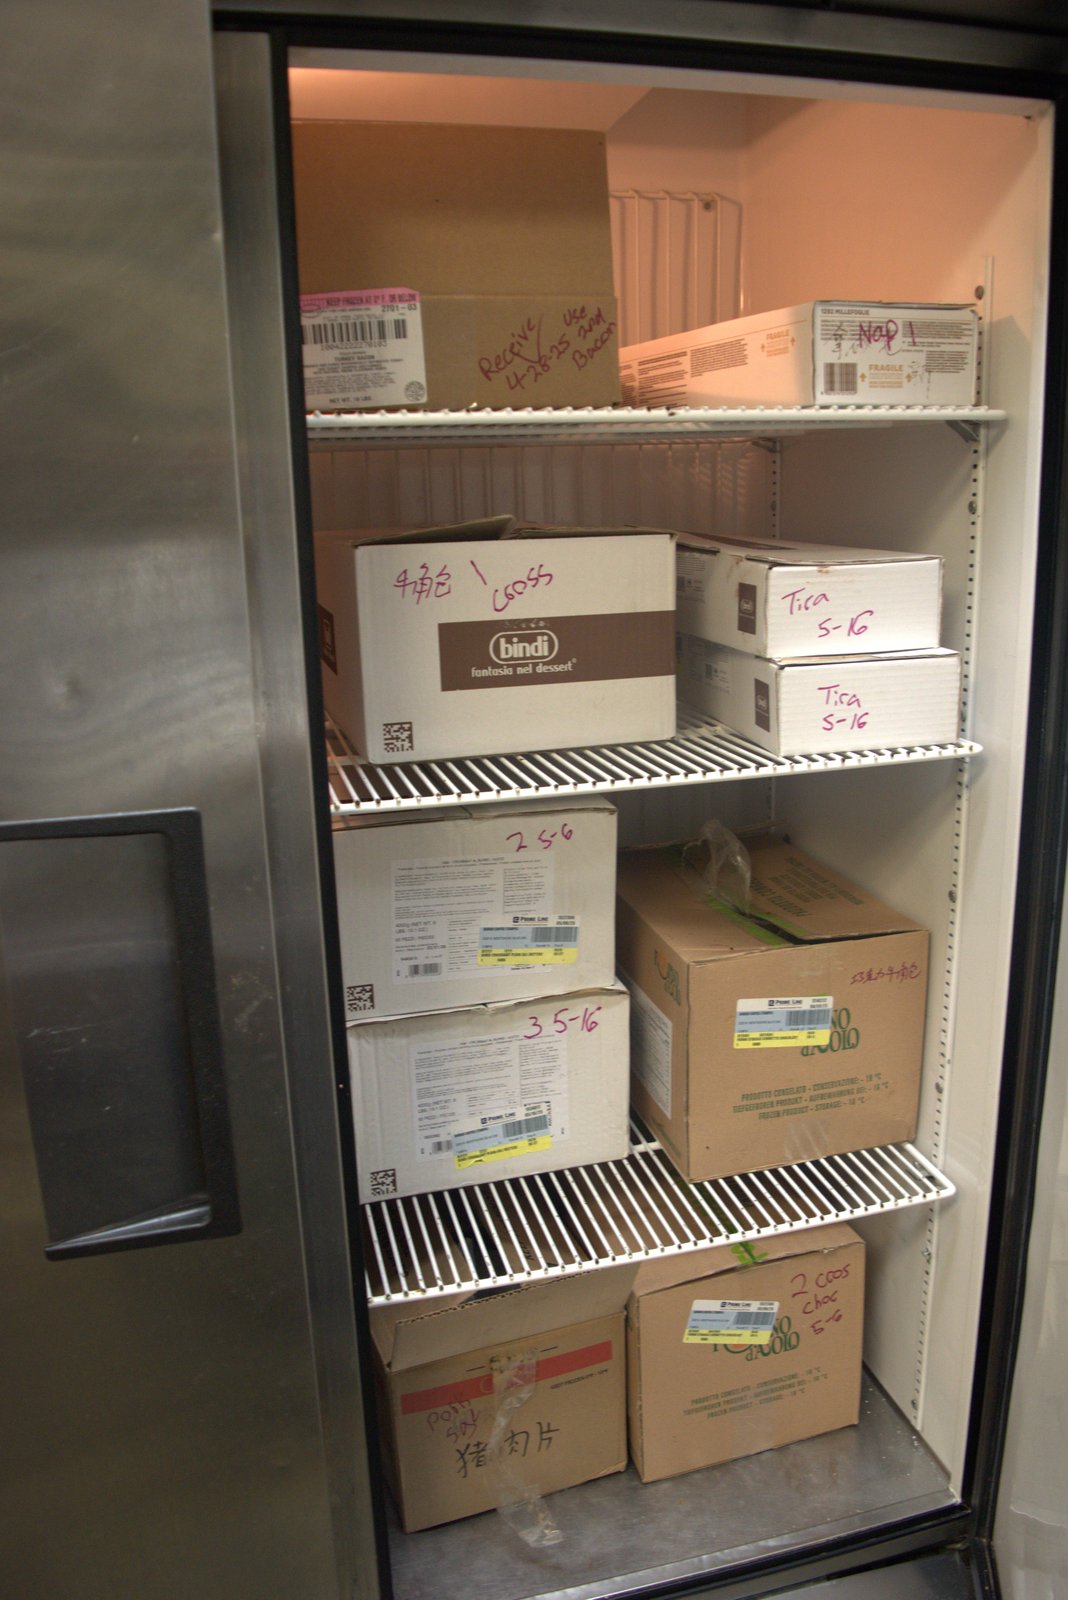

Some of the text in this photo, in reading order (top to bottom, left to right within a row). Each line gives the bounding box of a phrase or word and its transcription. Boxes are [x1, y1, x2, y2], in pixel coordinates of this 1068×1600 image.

[572, 322, 616, 371] Bacon
[500, 635, 549, 659] bindi
[471, 664, 513, 677] fantasia
[517, 663, 533, 675] nel
[505, 823, 573, 852] 2 5-6
[523, 1005, 603, 1039] 3 5-16
